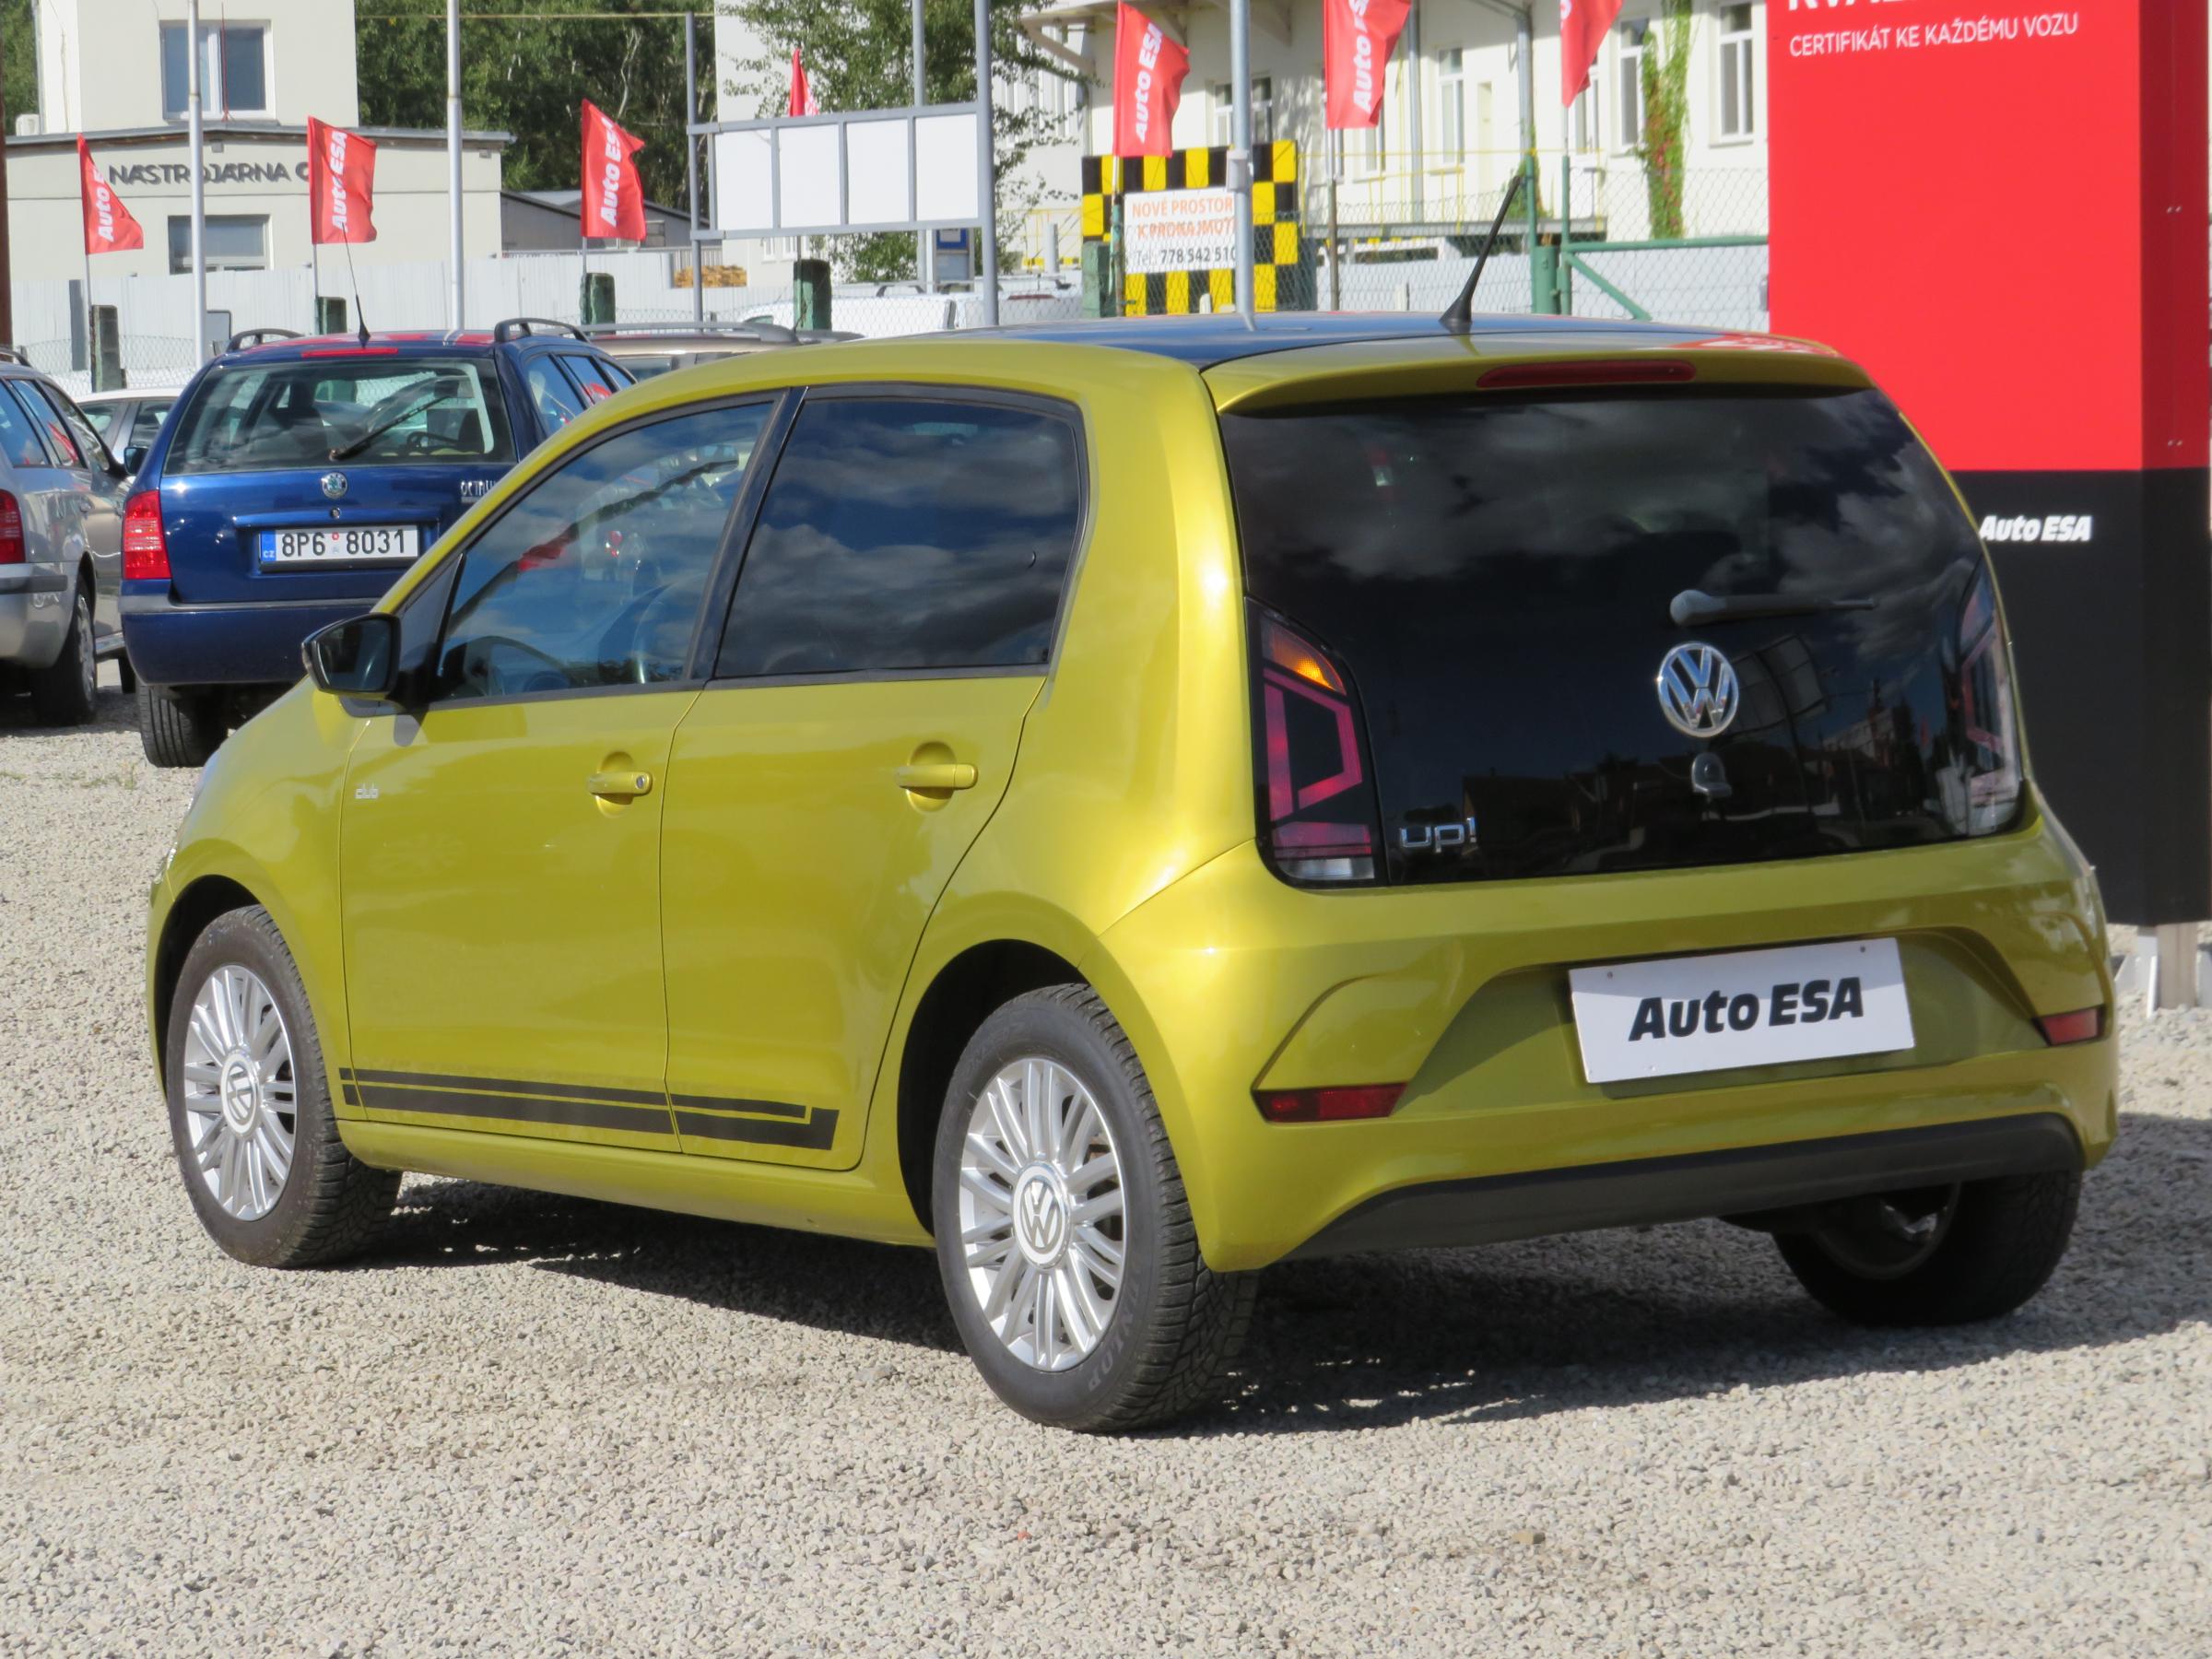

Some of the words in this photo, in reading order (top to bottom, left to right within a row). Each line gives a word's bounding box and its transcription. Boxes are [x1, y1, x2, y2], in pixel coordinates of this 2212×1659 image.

[1789, 25, 1890, 56] CERTIFIKÁT
[1896, 26, 1920, 48] KE
[1925, 16, 2018, 45] KAŽDÉMU
[2023, 12, 2078, 37] VOZU
[1353, 35, 1372, 114] Auto
[1135, 70, 1151, 144] Auto
[330, 131, 347, 175] ESA
[95, 187, 114, 242] Auto
[601, 162, 620, 228] Auto
[281, 532, 326, 557] 8P6
[346, 529, 406, 555] 8031
[1979, 514, 2041, 542] Auto
[2041, 514, 2093, 542] ESA
[1399, 817, 1477, 853] up!
[1628, 989, 1760, 1042] Auto
[1769, 976, 1865, 1027] ESA
